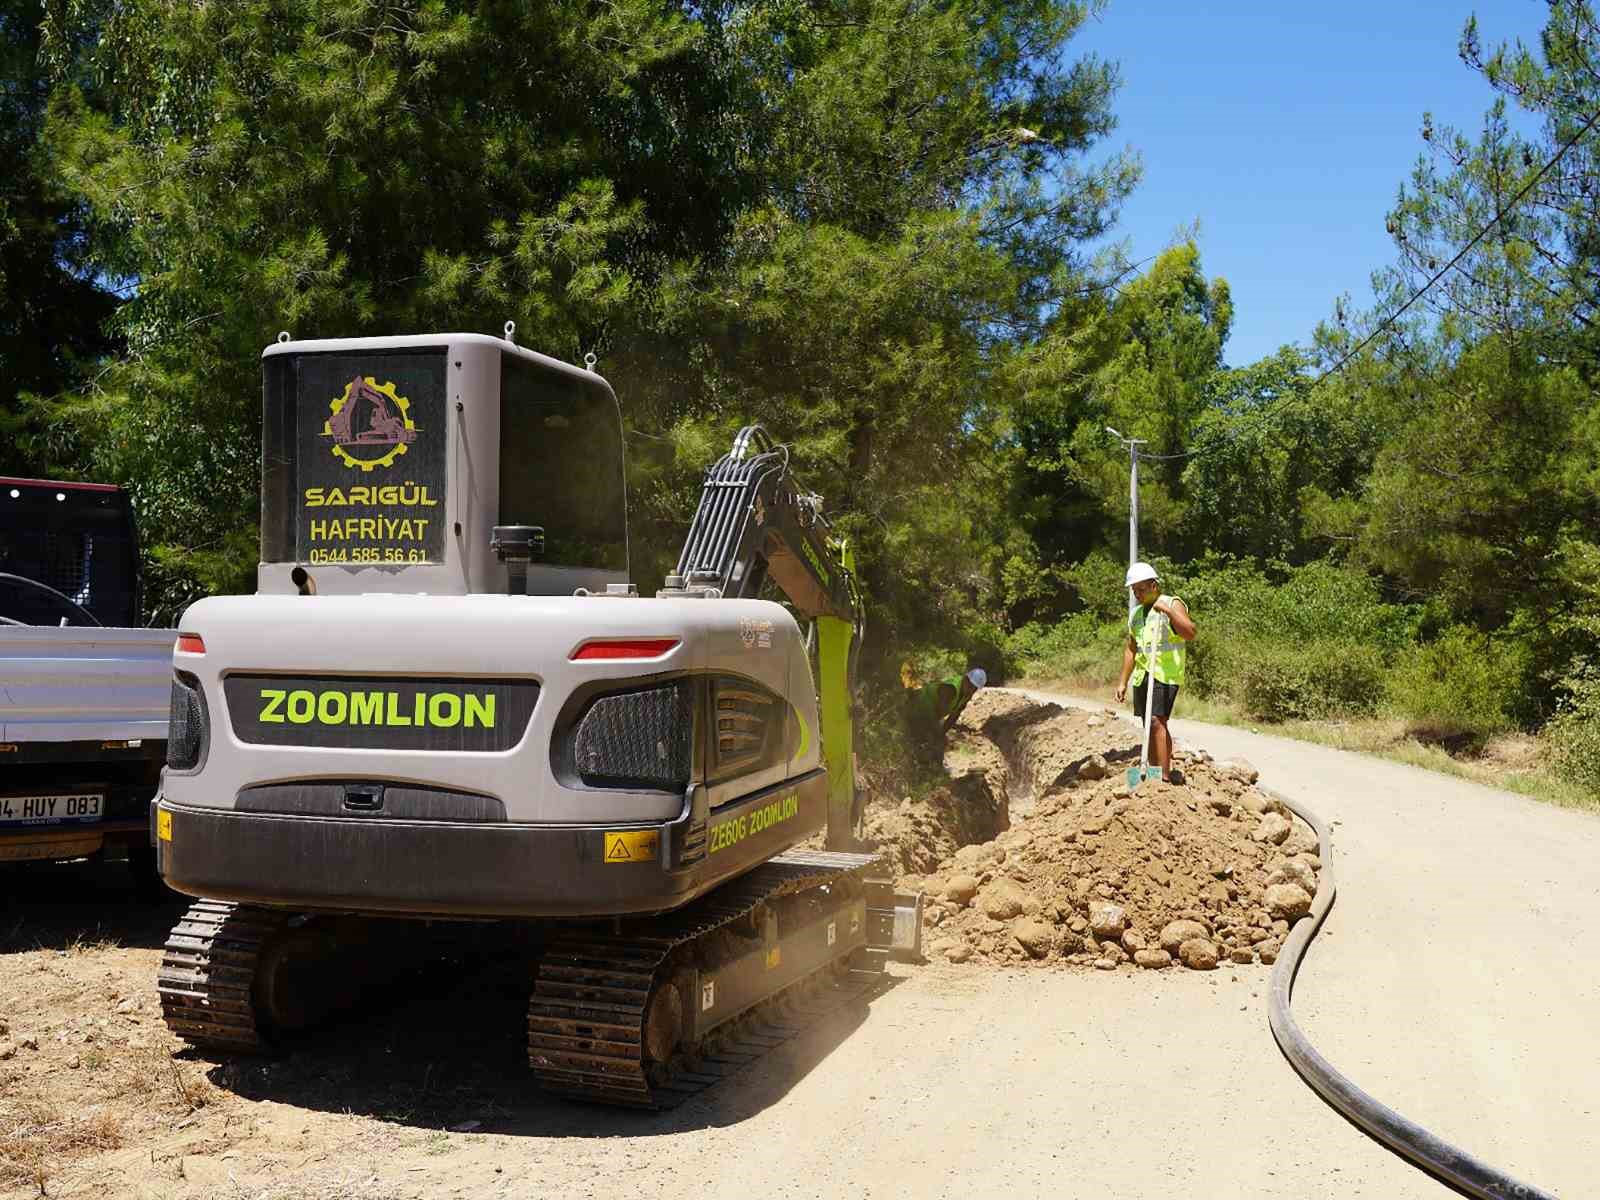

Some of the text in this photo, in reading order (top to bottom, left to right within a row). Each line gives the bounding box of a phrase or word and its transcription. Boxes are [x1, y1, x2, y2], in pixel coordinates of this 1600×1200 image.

[304, 480, 438, 507] SARIGÜL
[310, 514, 429, 540] HAFRİYAT
[310, 548, 427, 565] 0544 585 56 61
[259, 689, 496, 728] ZOOMLION
[0, 797, 99, 818] 4 HUY 083
[710, 793, 799, 852] ZE60G ZOOMLION
